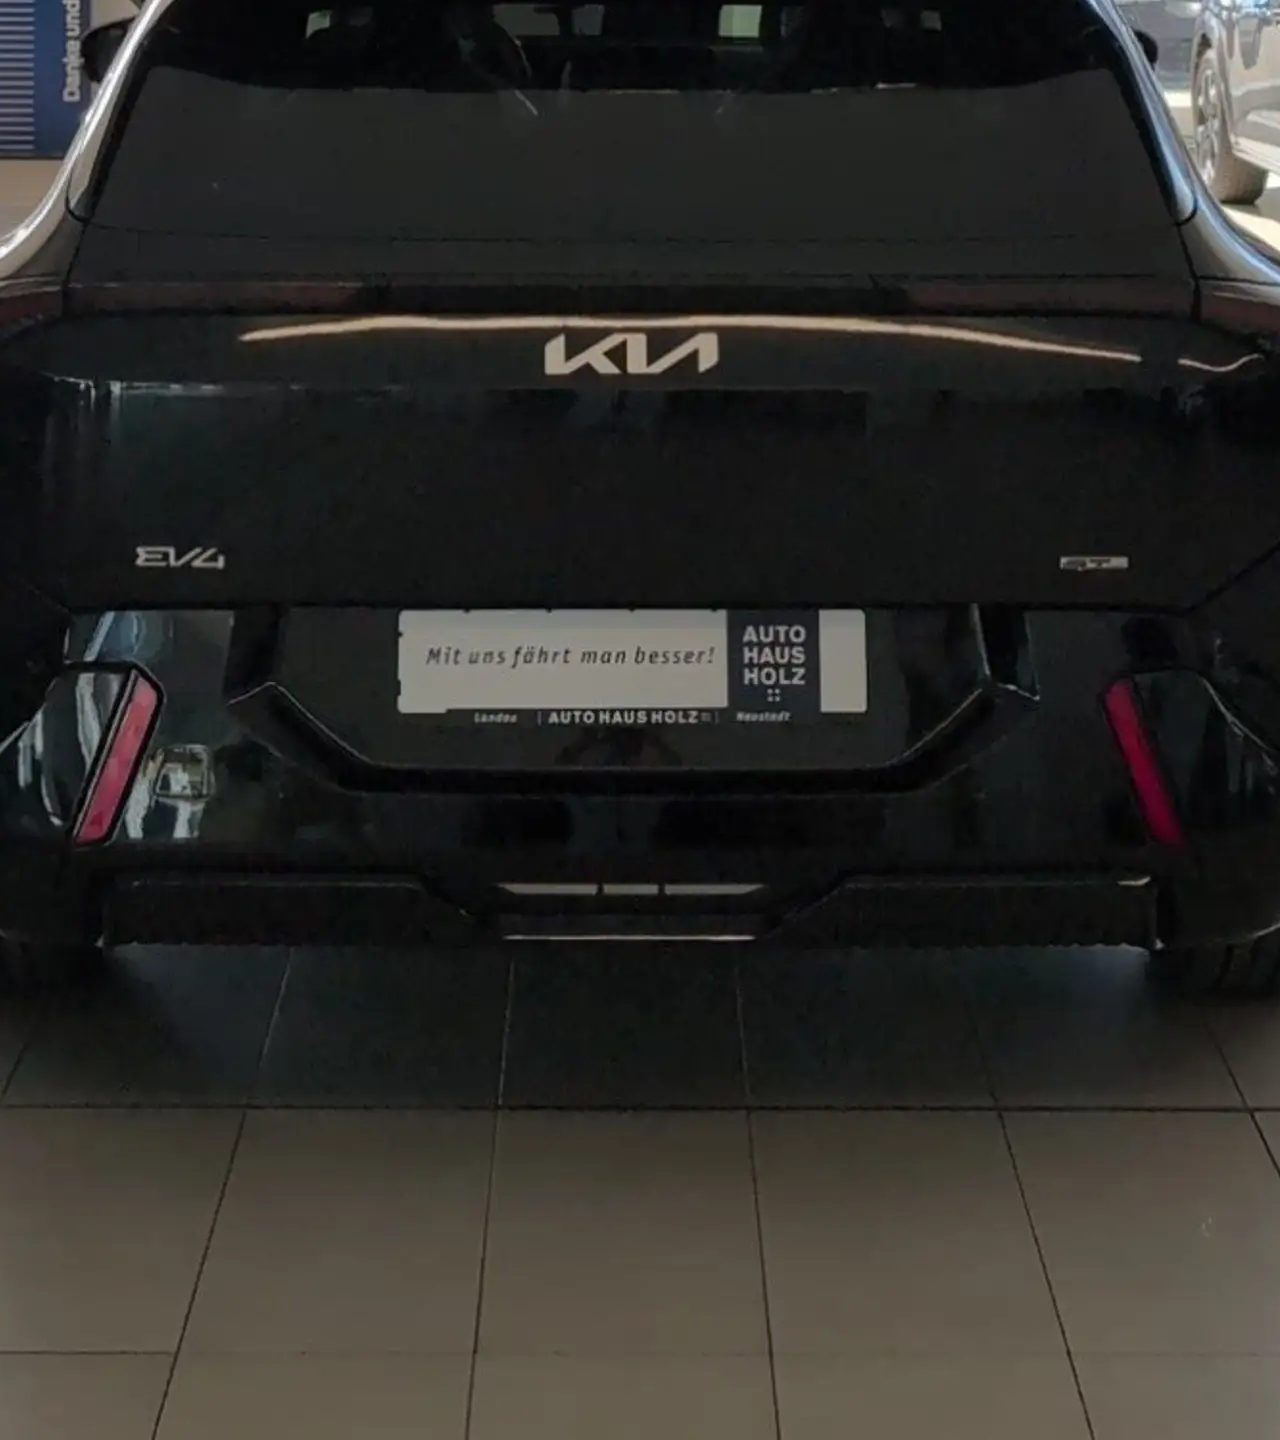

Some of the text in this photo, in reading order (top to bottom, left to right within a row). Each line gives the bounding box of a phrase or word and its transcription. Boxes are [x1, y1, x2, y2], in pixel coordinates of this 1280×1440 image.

[62, 39, 83, 102] Danke
[544, 332, 719, 375] KIA
[135, 546, 225, 570] EV4
[742, 624, 807, 643] AUTO
[426, 645, 715, 669] Mit uns fährt man besser!
[743, 646, 806, 664] HAUS
[743, 667, 806, 685] HOLZ
[548, 710, 595, 724] AUTO
[599, 710, 648, 724] HAUS
[651, 710, 698, 724] HOLZ
